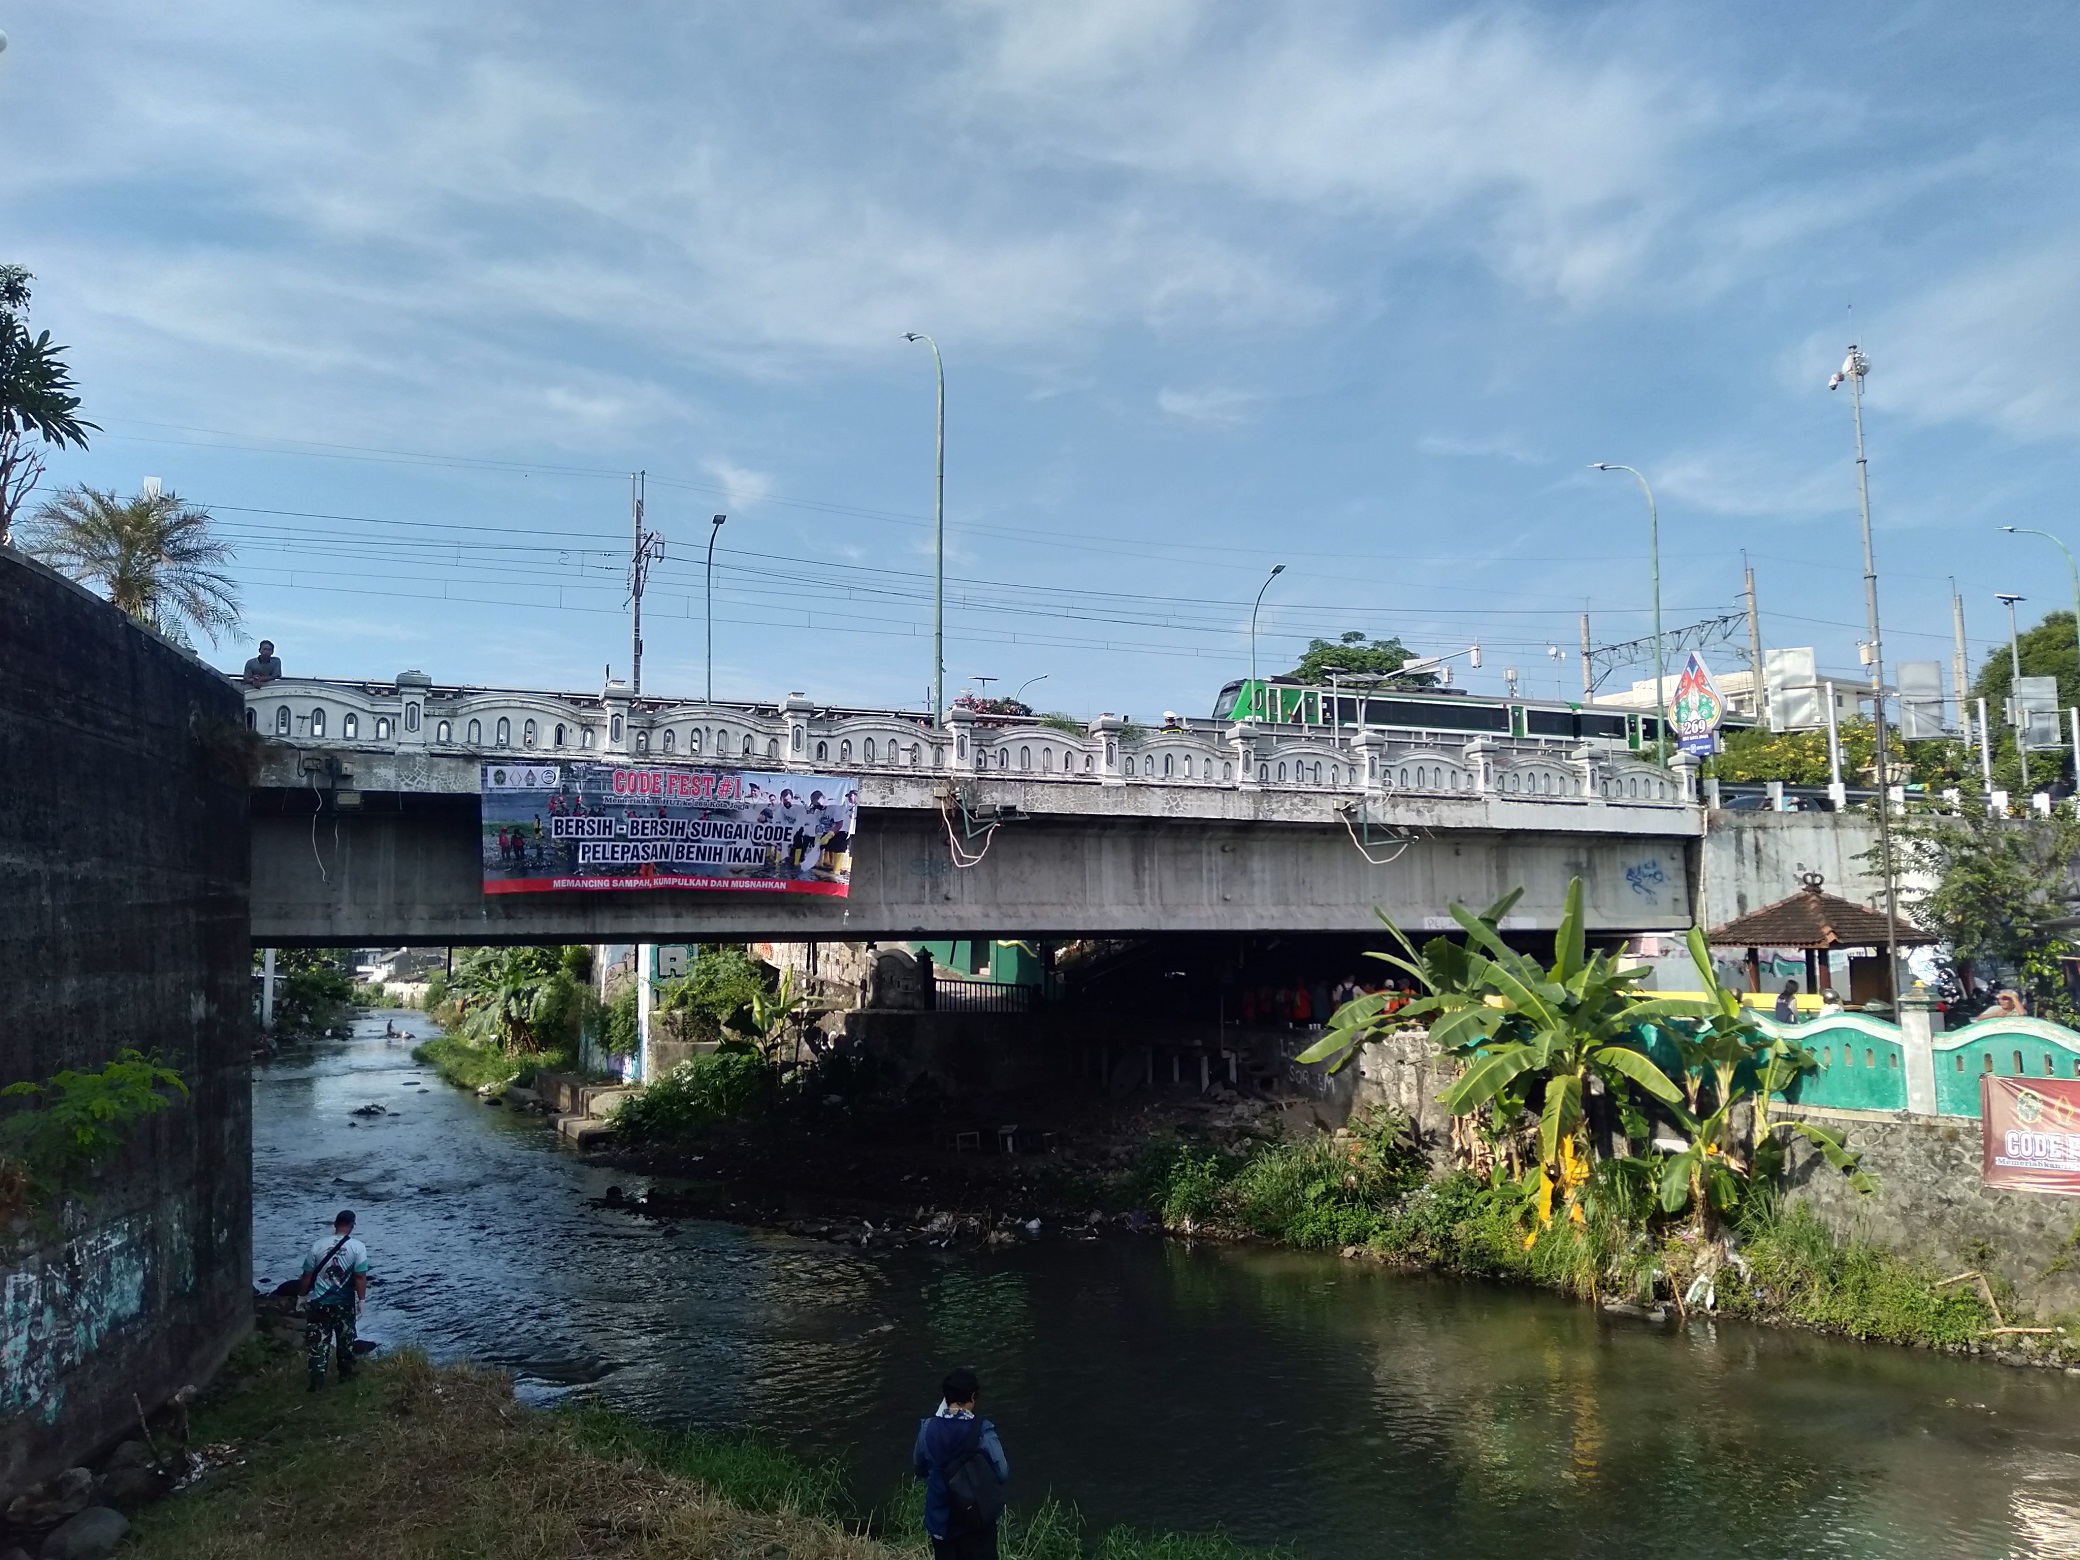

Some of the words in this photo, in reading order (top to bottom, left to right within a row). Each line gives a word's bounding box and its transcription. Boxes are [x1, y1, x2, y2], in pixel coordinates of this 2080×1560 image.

[1684, 719, 1706, 735] 269
[613, 770, 663, 797] CODE
[666, 773, 715, 799] FEST
[718, 776, 742, 800] #1
[604, 797, 660, 805] Memeriahkan
[709, 801, 728, 809] Kota
[729, 802, 750, 810] Jogja
[553, 818, 614, 837] BERSIH
[629, 819, 687, 838] BERSIH
[690, 821, 749, 840] SUNGAI
[753, 825, 793, 842] CODE
[581, 843, 671, 861] PELEPASAN
[674, 844, 723, 863] BENIH
[727, 846, 765, 864] IKAN
[553, 879, 610, 888] MEMANCING
[612, 879, 652, 888] SAMPAH,
[653, 877, 708, 888] KUMPULKAN
[710, 879, 729, 888] DAN
[731, 880, 787, 890] MUSNAHKAN
[2006, 1130, 2064, 1160] CODE
[1997, 1157, 2061, 1169] Memeriahkan
